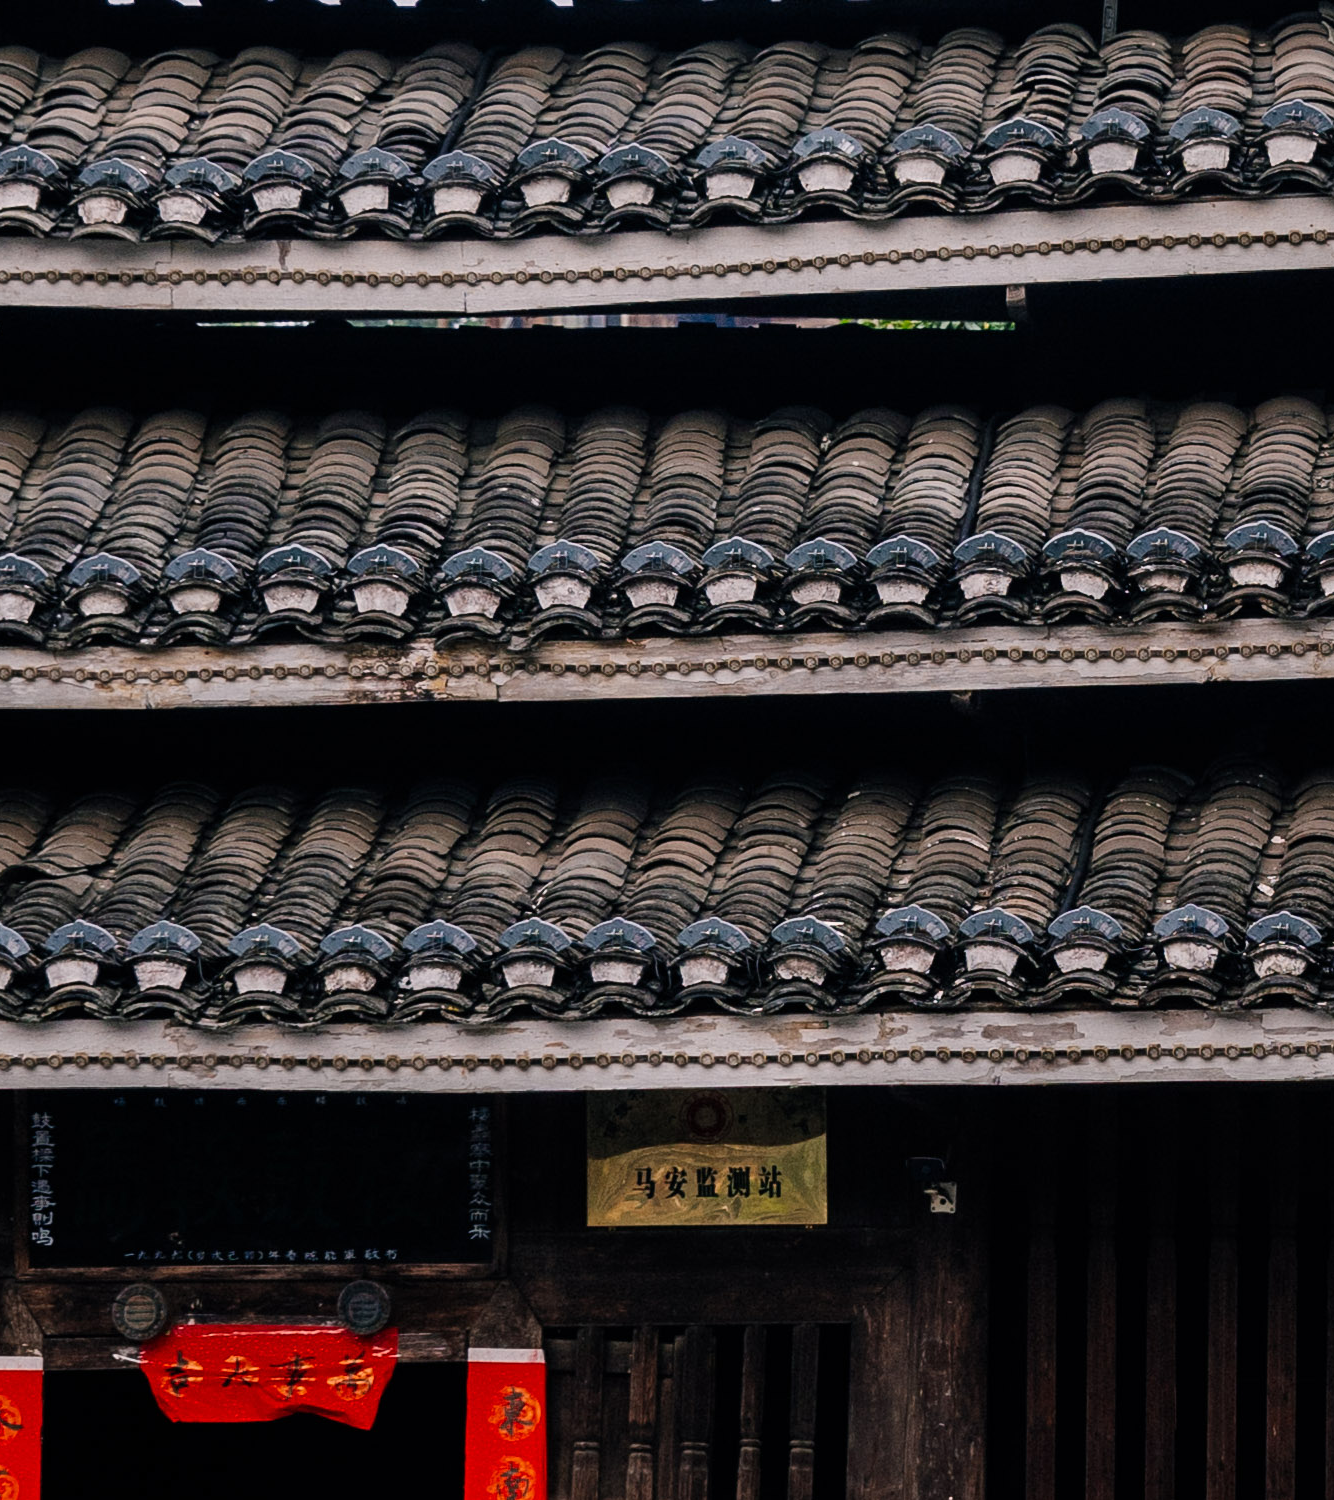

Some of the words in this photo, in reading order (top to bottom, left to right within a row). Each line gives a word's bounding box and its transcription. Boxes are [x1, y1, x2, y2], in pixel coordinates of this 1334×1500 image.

[632, 1165, 782, 1199] 马安监测站
